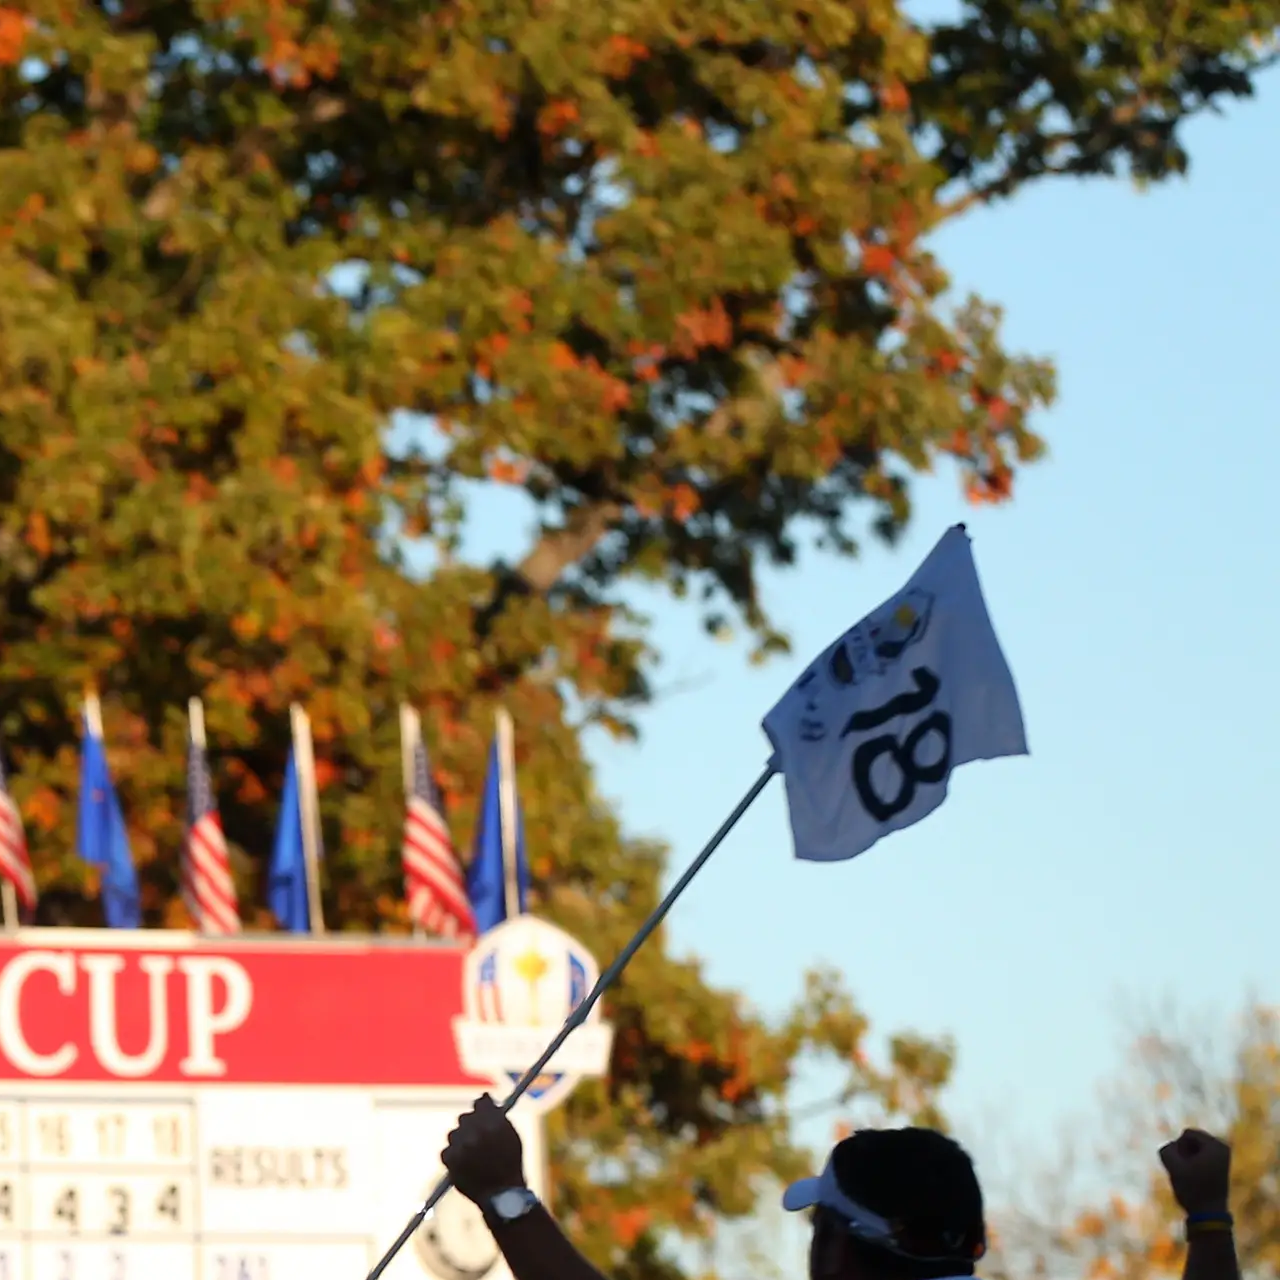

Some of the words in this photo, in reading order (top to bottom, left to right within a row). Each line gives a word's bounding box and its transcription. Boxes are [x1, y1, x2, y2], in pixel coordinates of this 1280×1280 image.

[840, 667, 952, 822] 18
[210, 1145, 350, 1192] RESULTS
[51, 1183, 82, 1238] 4
[103, 1183, 134, 1239] 3
[154, 1181, 182, 1224] 4
